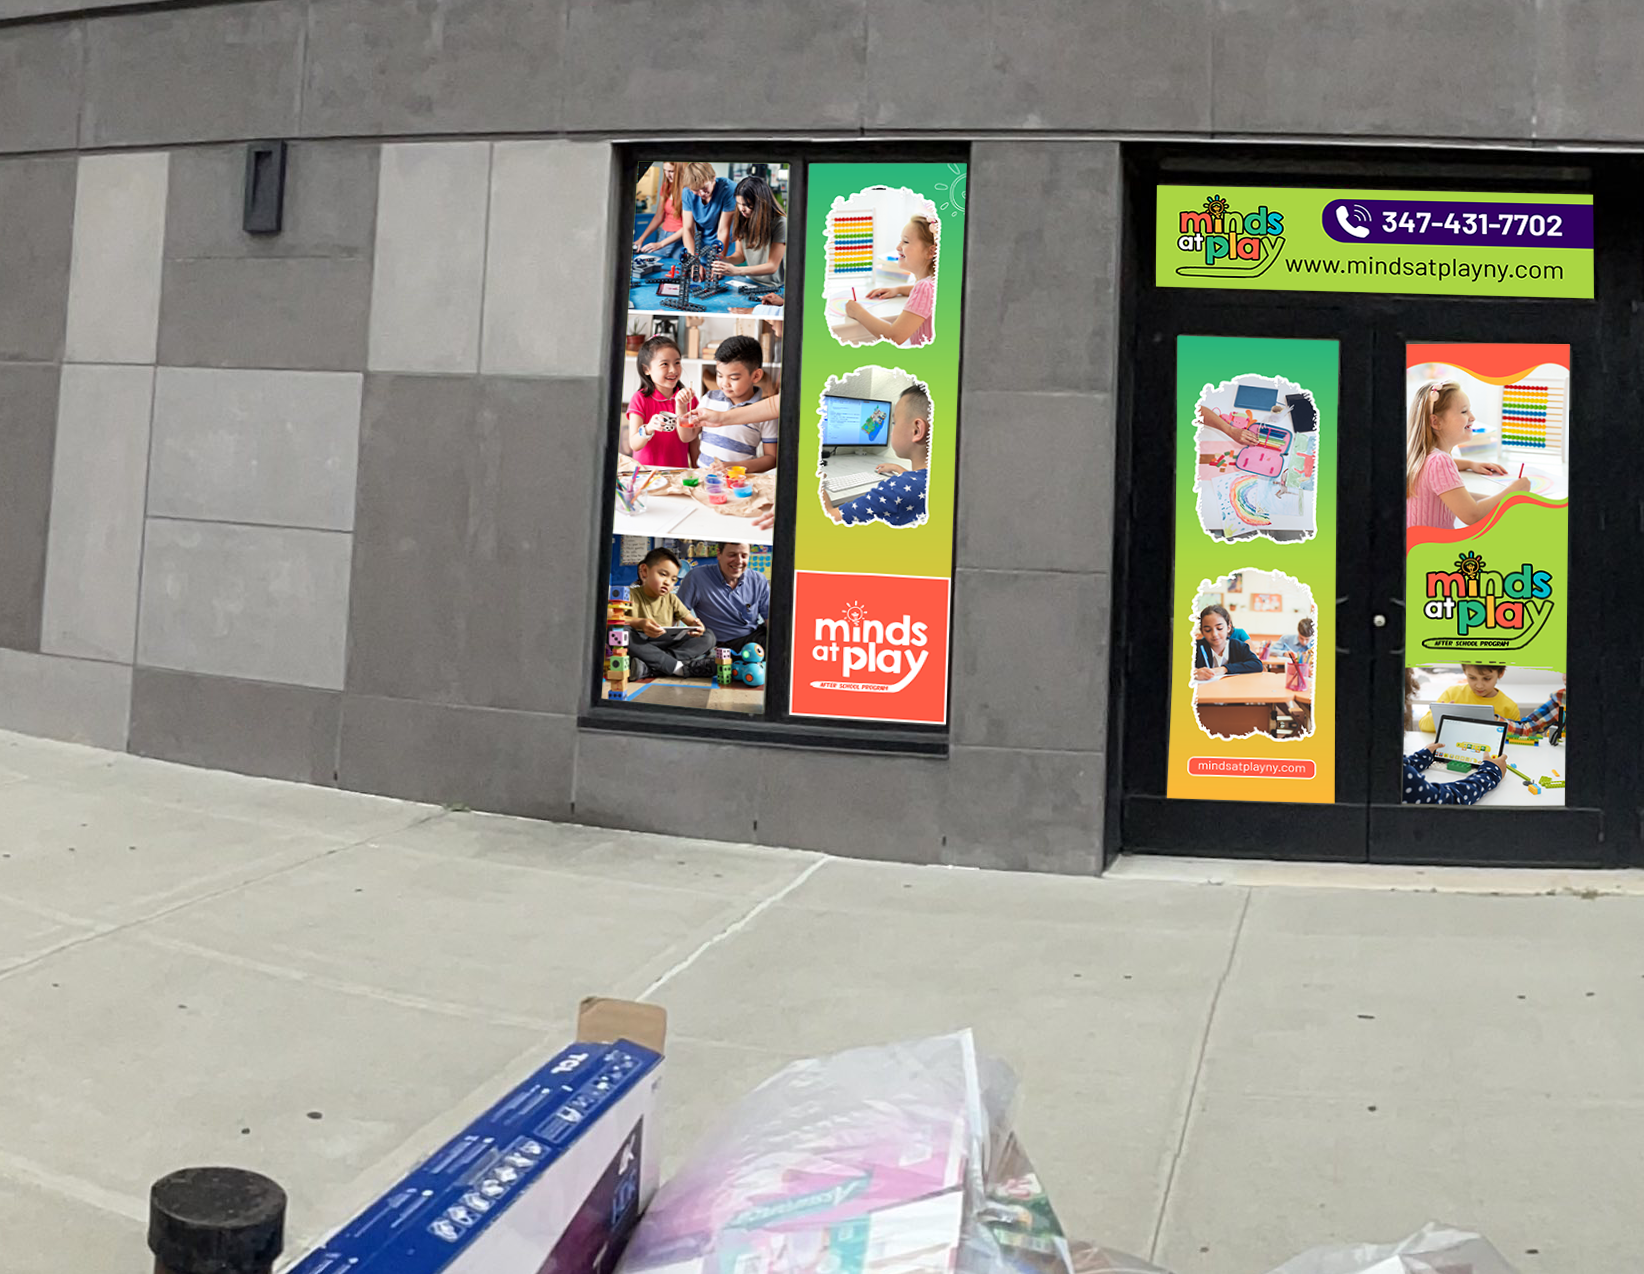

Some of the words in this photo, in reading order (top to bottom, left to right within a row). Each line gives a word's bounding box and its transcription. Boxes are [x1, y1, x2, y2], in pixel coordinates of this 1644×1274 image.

[1179, 204, 1285, 236] minds
[1381, 210, 1563, 238] 347-431-7702
[1176, 233, 1204, 252] at
[1204, 232, 1286, 269] play
[1285, 256, 1564, 282] www.mindsatplayny.com
[1425, 560, 1553, 600] minds
[814, 612, 929, 647] minds
[1423, 596, 1456, 620] at
[1456, 593, 1555, 640] play
[1479, 640, 1510, 648] PROGRAM
[811, 642, 840, 662] at
[842, 641, 930, 682] play
[1197, 759, 1307, 775] mindsatplayny.com
